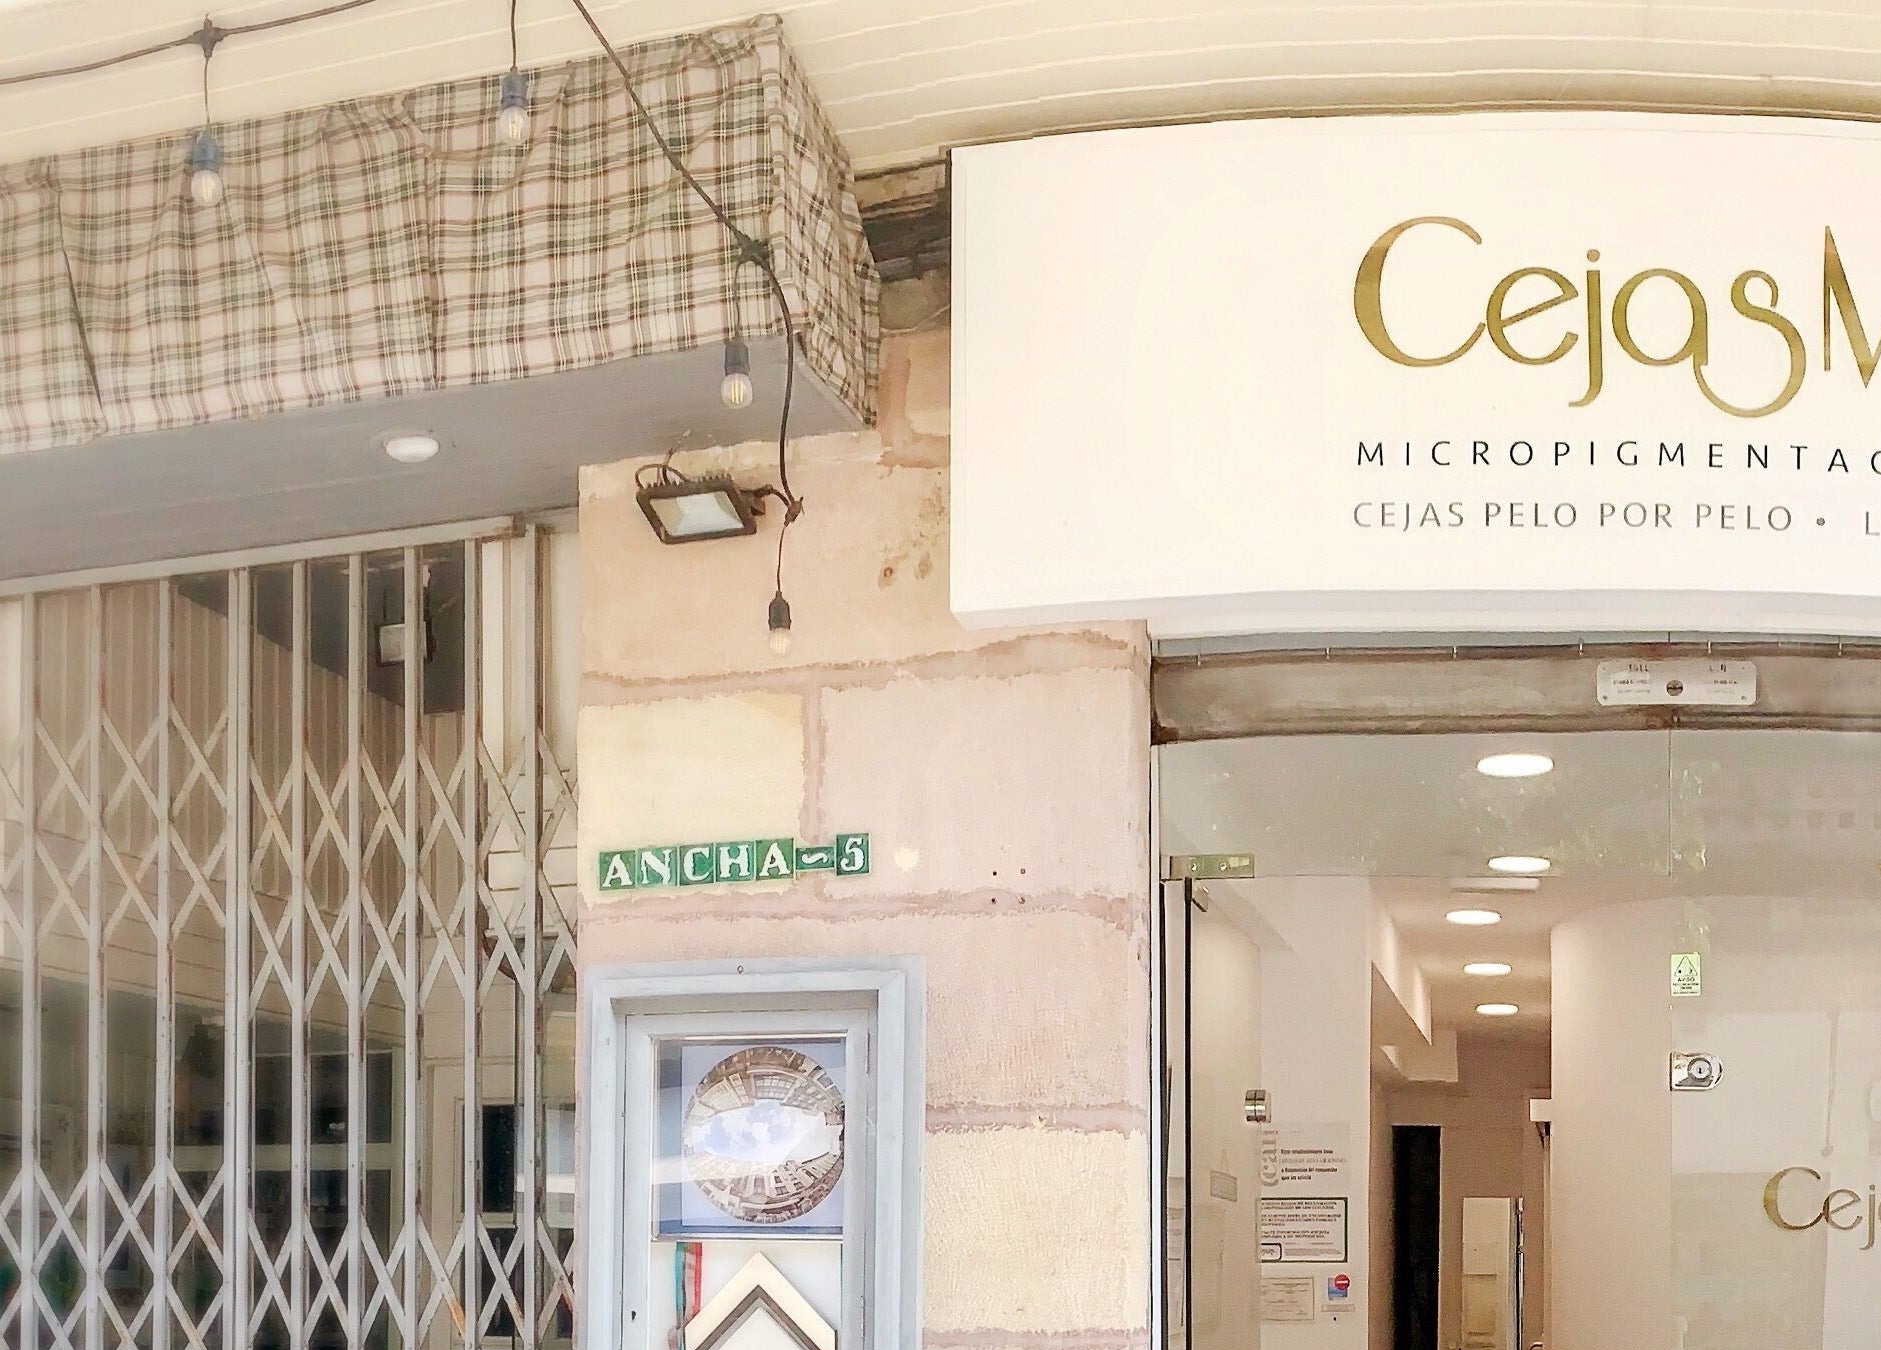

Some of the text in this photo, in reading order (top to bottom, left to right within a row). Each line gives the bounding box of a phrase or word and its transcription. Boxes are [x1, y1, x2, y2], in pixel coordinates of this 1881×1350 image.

[1353, 502, 1466, 531] CEJAS
[1484, 502, 1578, 529] PELO
[1600, 503, 1673, 529] POR
[1696, 504, 1793, 532] PELO
[602, 842, 792, 888] ANCHA
[839, 835, 867, 872] 5
